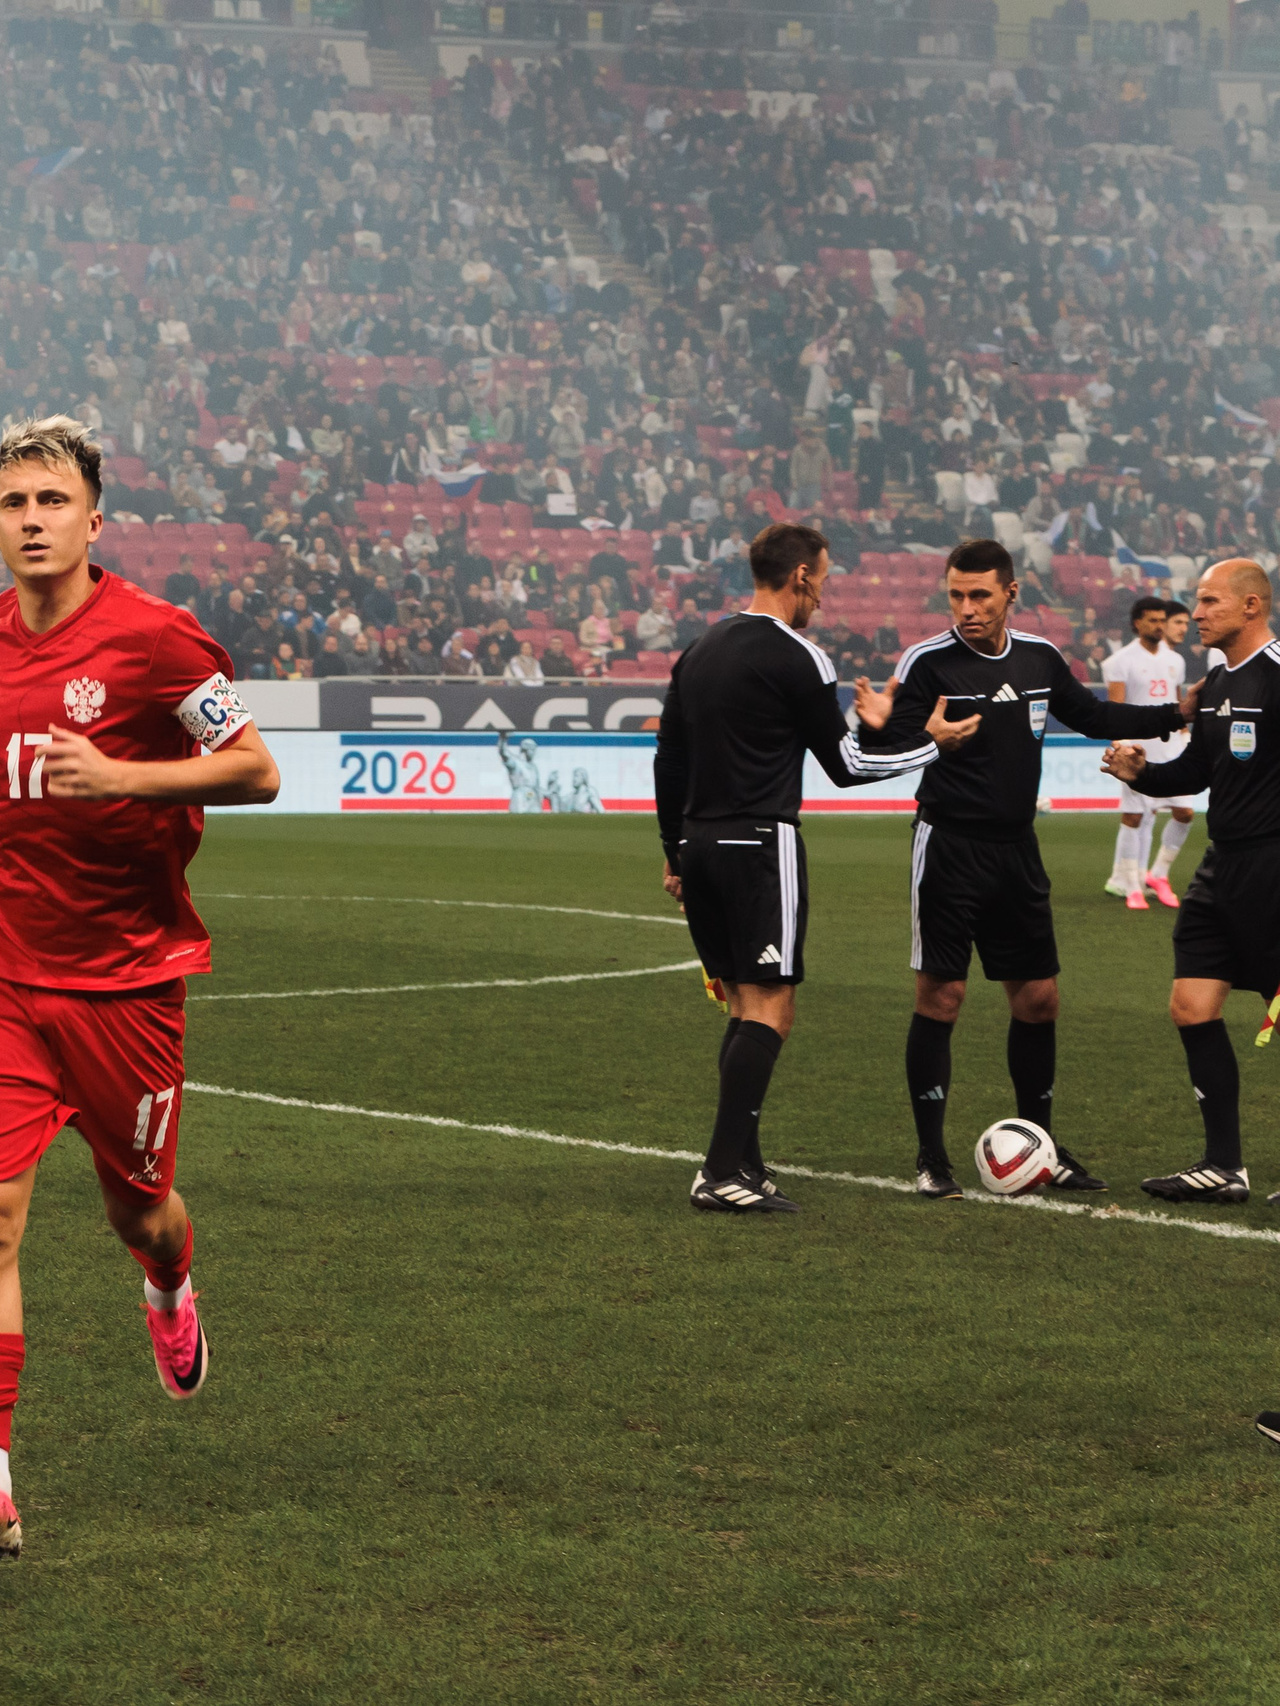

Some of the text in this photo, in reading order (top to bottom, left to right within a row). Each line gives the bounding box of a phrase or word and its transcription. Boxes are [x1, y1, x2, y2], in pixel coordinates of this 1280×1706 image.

[1149, 679, 1168, 697] 23
[199, 697, 227, 726] C
[1232, 724, 1253, 734] FIFA
[6, 732, 53, 799] 17
[340, 750, 456, 795] 2026
[132, 1085, 175, 1151] 17
